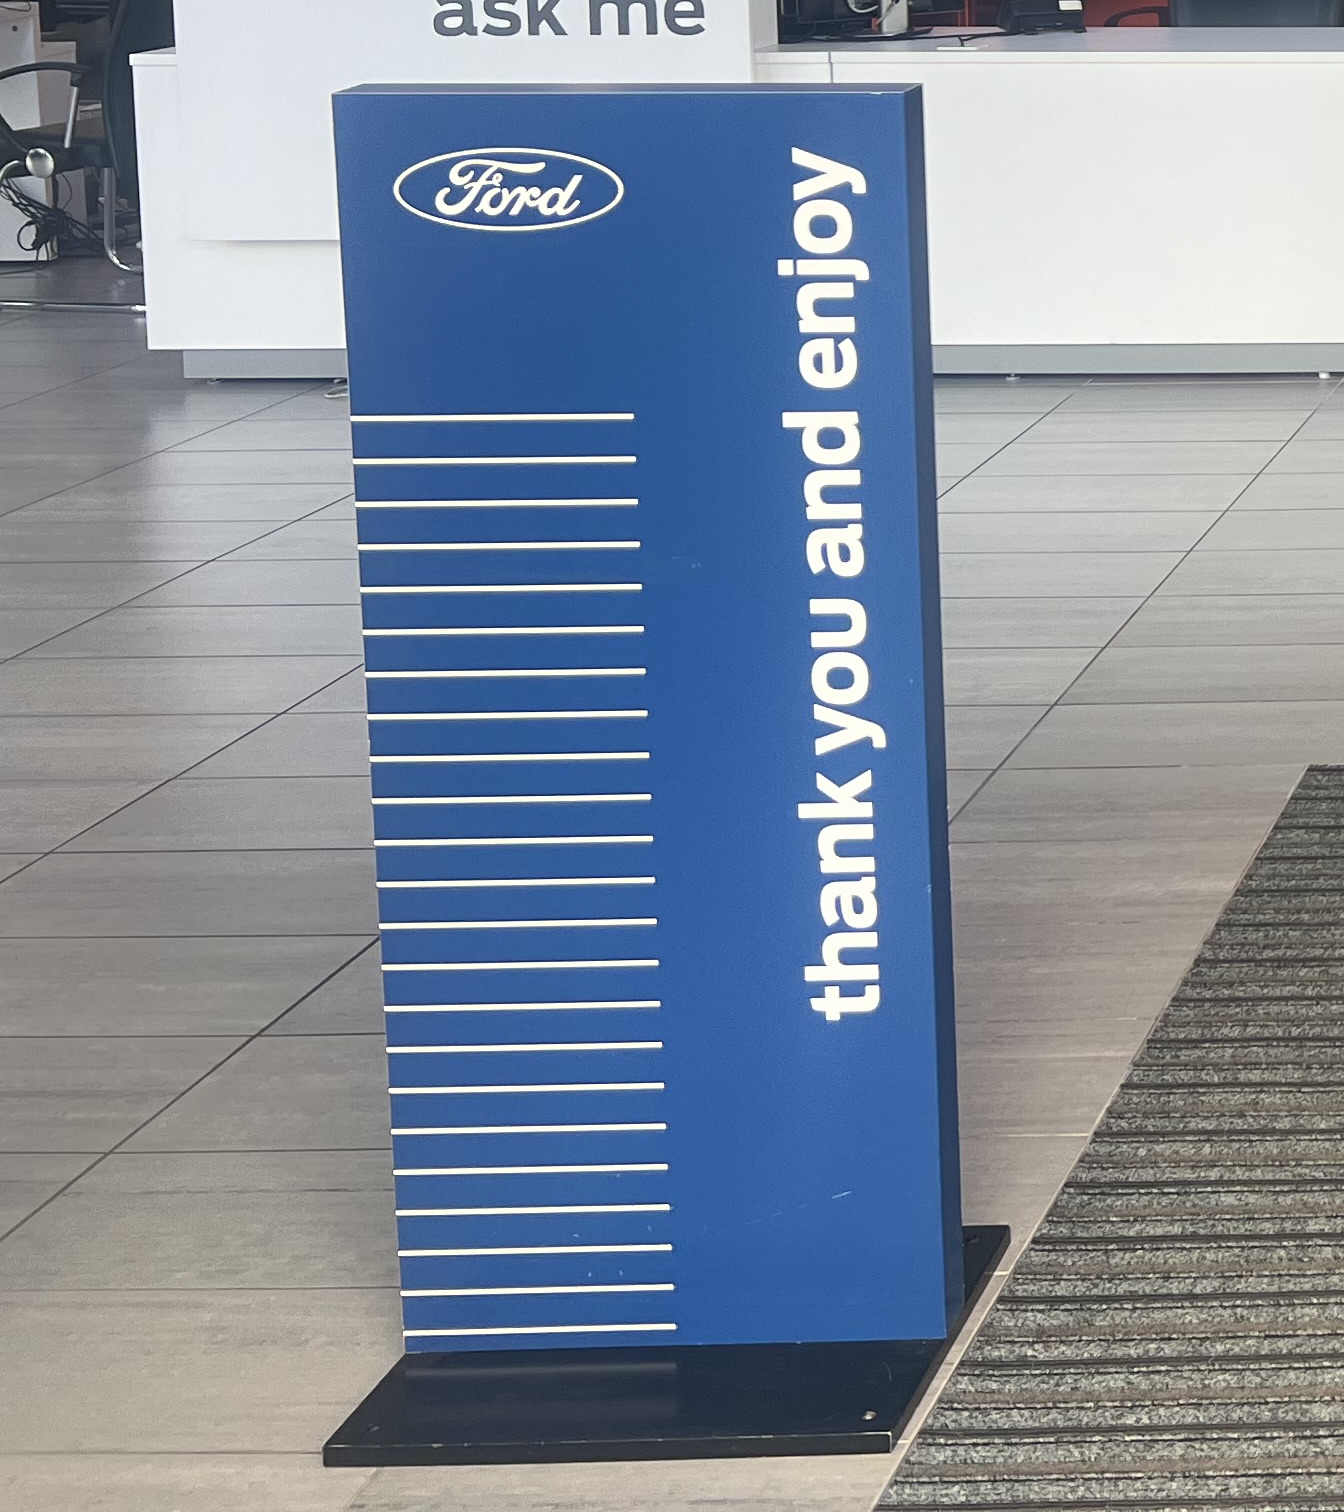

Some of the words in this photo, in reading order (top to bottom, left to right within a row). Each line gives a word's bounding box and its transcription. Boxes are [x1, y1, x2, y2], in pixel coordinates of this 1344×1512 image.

[435, 159, 583, 216] Ford
[777, 146, 869, 390] enjoy
[782, 411, 866, 576] and
[808, 598, 886, 750] you
[798, 768, 881, 1023] thank
